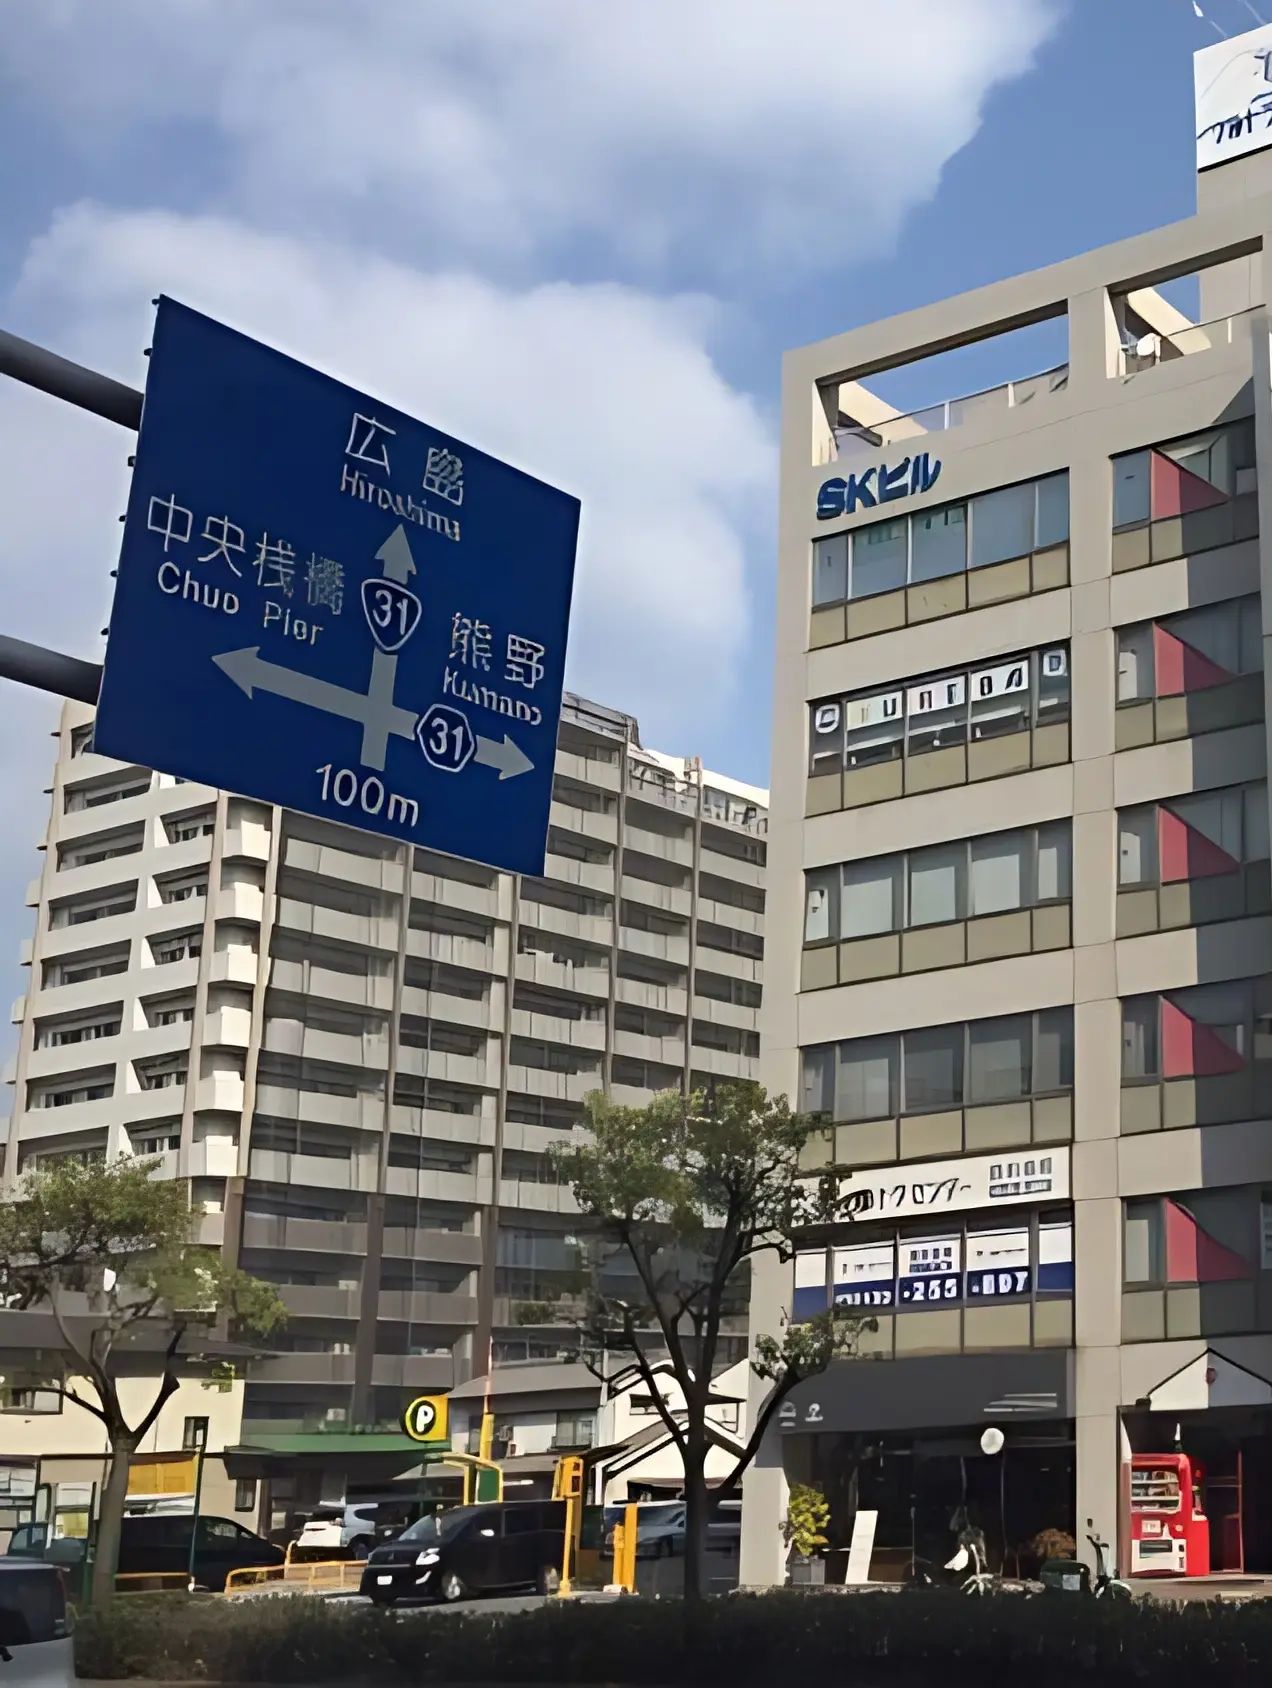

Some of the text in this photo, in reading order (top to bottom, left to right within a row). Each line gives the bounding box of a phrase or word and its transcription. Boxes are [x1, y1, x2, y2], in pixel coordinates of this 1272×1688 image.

[157, 561, 324, 645] Chuo Pier
[372, 589, 409, 636] 31
[449, 612, 545, 689] 熊野
[429, 717, 464, 761] 31
[316, 764, 419, 828] 100m
[416, 1405, 434, 1432] P
